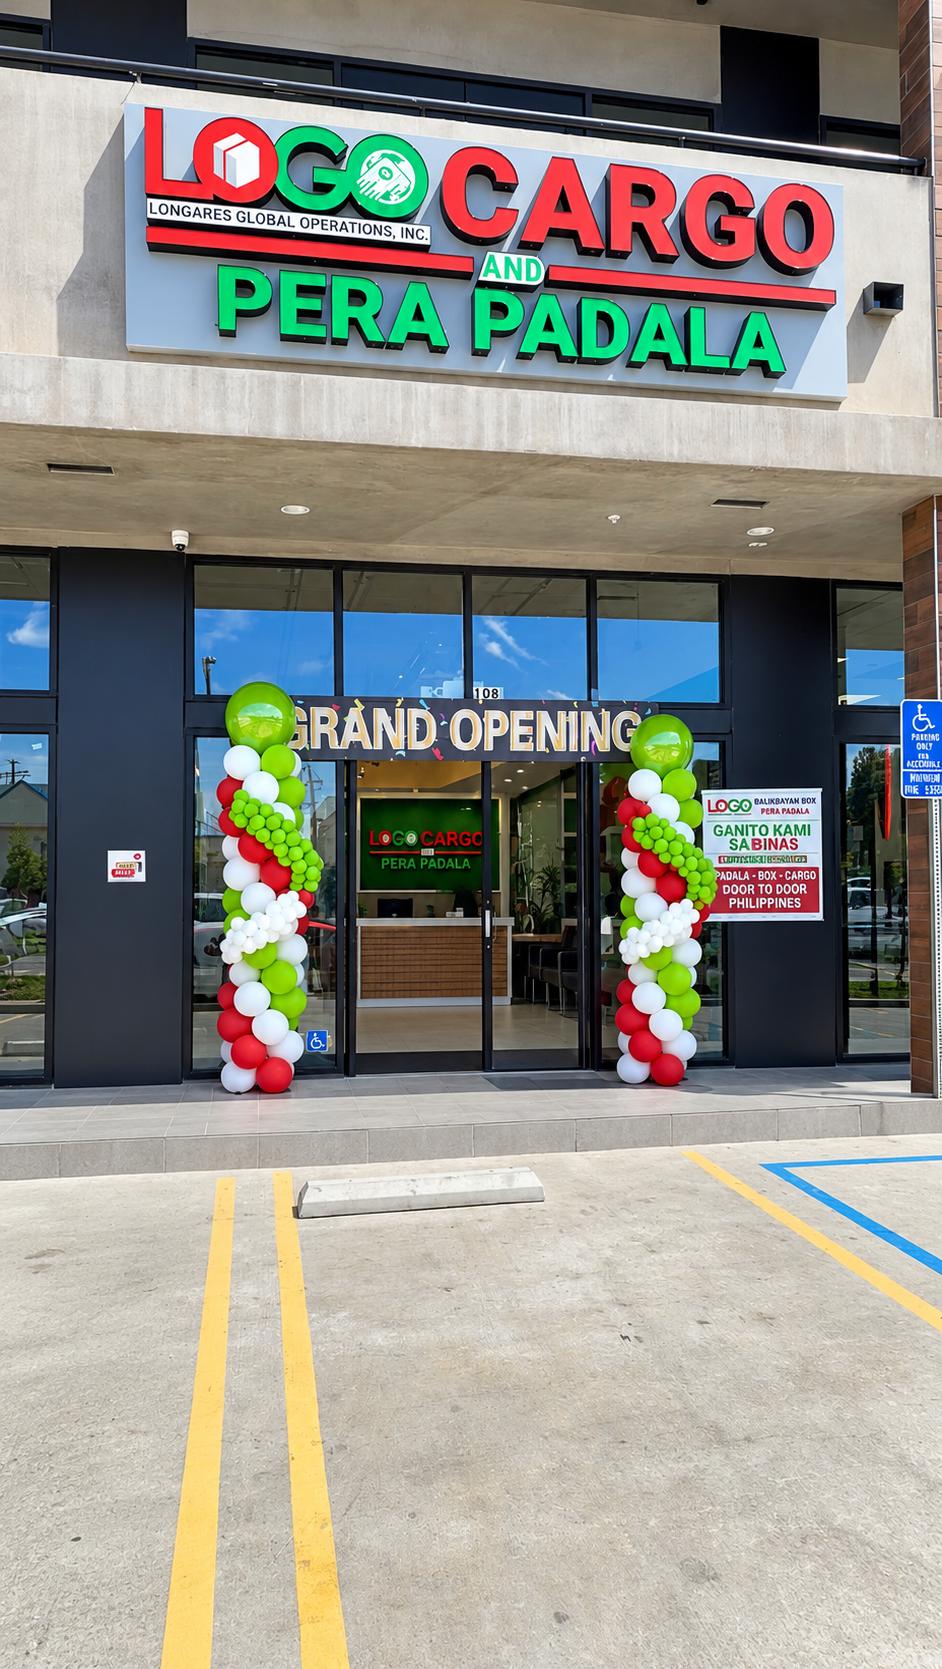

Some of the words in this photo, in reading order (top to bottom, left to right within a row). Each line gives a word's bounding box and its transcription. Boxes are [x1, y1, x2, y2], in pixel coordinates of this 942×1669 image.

[144, 107, 429, 220] LOGO
[441, 146, 835, 273] CARGO
[149, 202, 232, 221] LONGARES
[236, 210, 295, 228] GLOBAL
[300, 216, 396, 239] OPERATIONS,
[400, 226, 429, 241] INC.
[482, 254, 543, 283] AND
[217, 264, 450, 353] PERA
[471, 286, 786, 378] PADALA
[474, 687, 499, 699] 108
[288, 706, 437, 751] GRAND
[450, 708, 642, 752] OPENING
[707, 799, 752, 813] LOGO
[754, 797, 800, 806] BALIKBAYAN
[801, 797, 817, 805] BOX
[781, 807, 810, 815] PADALA
[713, 824, 769, 837] GANITO
[773, 824, 811, 837] KAMI
[369, 830, 418, 846] LOGO
[420, 831, 483, 847] CARGO
[381, 858, 416, 870] PERA
[420, 858, 471, 870] PADALA
[716, 871, 750, 881] PADALA
[758, 871, 777, 881] BOX
[785, 870, 816, 880] CARGO
[723, 885, 755, 895] DOOR
[758, 885, 772, 895] TO
[775, 884, 807, 895] DOOR
[729, 898, 801, 908] PHILIPPINES
